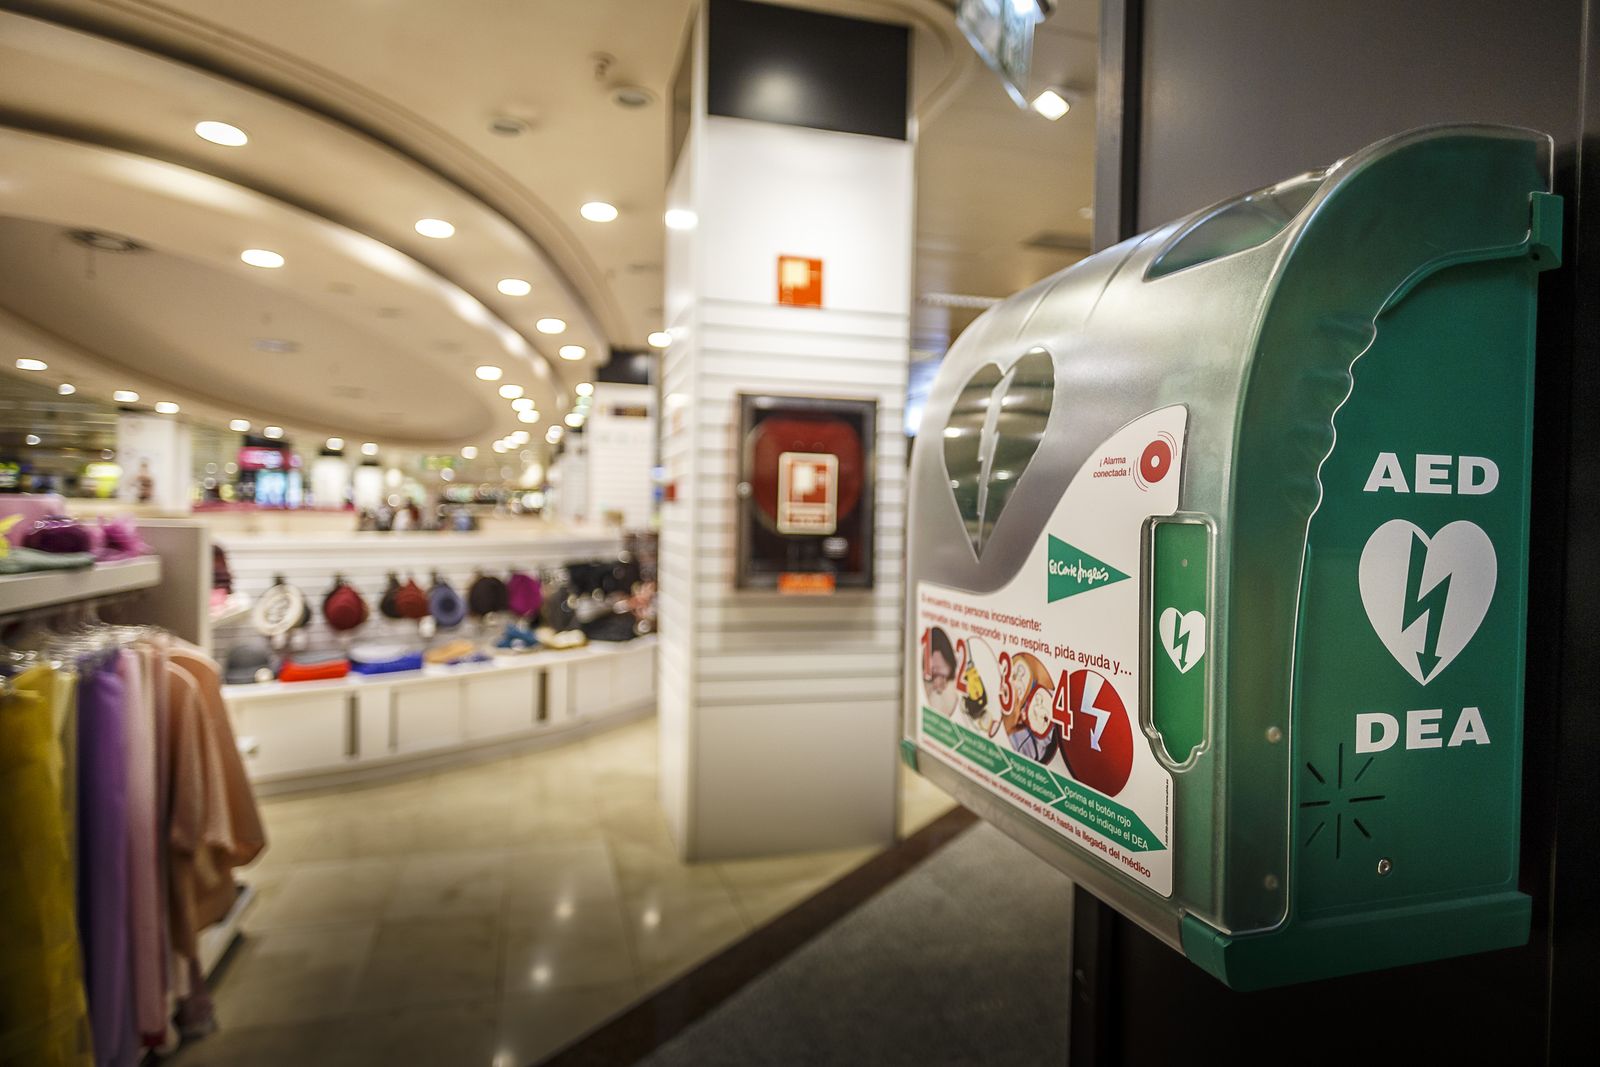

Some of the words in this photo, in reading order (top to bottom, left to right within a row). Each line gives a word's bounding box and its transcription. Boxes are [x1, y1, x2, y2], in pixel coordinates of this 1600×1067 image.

[1363, 452, 1499, 495] AED
[1049, 559, 1057, 575] El
[1058, 560, 1077, 578] Corte
[1077, 558, 1109, 584] Inglés
[991, 611, 1042, 632] inconsciente:
[921, 627, 931, 677] 1
[956, 638, 968, 693] 2
[1003, 633, 1008, 643] y
[1009, 633, 1019, 646] no
[1021, 636, 1052, 657] respira,
[1055, 644, 1075, 660] pida
[1078, 651, 1110, 668] ayuda
[1113, 660, 1132, 676] y...
[999, 651, 1013, 712] 3
[1052, 669, 1073, 739] 4
[1355, 706, 1491, 754] DEA
[1064, 800, 1088, 818] cuando
[1089, 811, 1095, 822] lo
[1096, 816, 1121, 836] indique
[1124, 831, 1130, 840] el
[1131, 834, 1148, 851] DEA
[1065, 786, 1088, 805] Oprima
[1088, 799, 1095, 809] el
[1096, 801, 1116, 819] botón
[1117, 814, 1131, 828] rojo
[1056, 816, 1074, 832] hasta
[1075, 826, 1081, 837] la
[1082, 829, 1107, 853] llegada
[1108, 847, 1120, 859] del
[1121, 855, 1151, 878] médico
